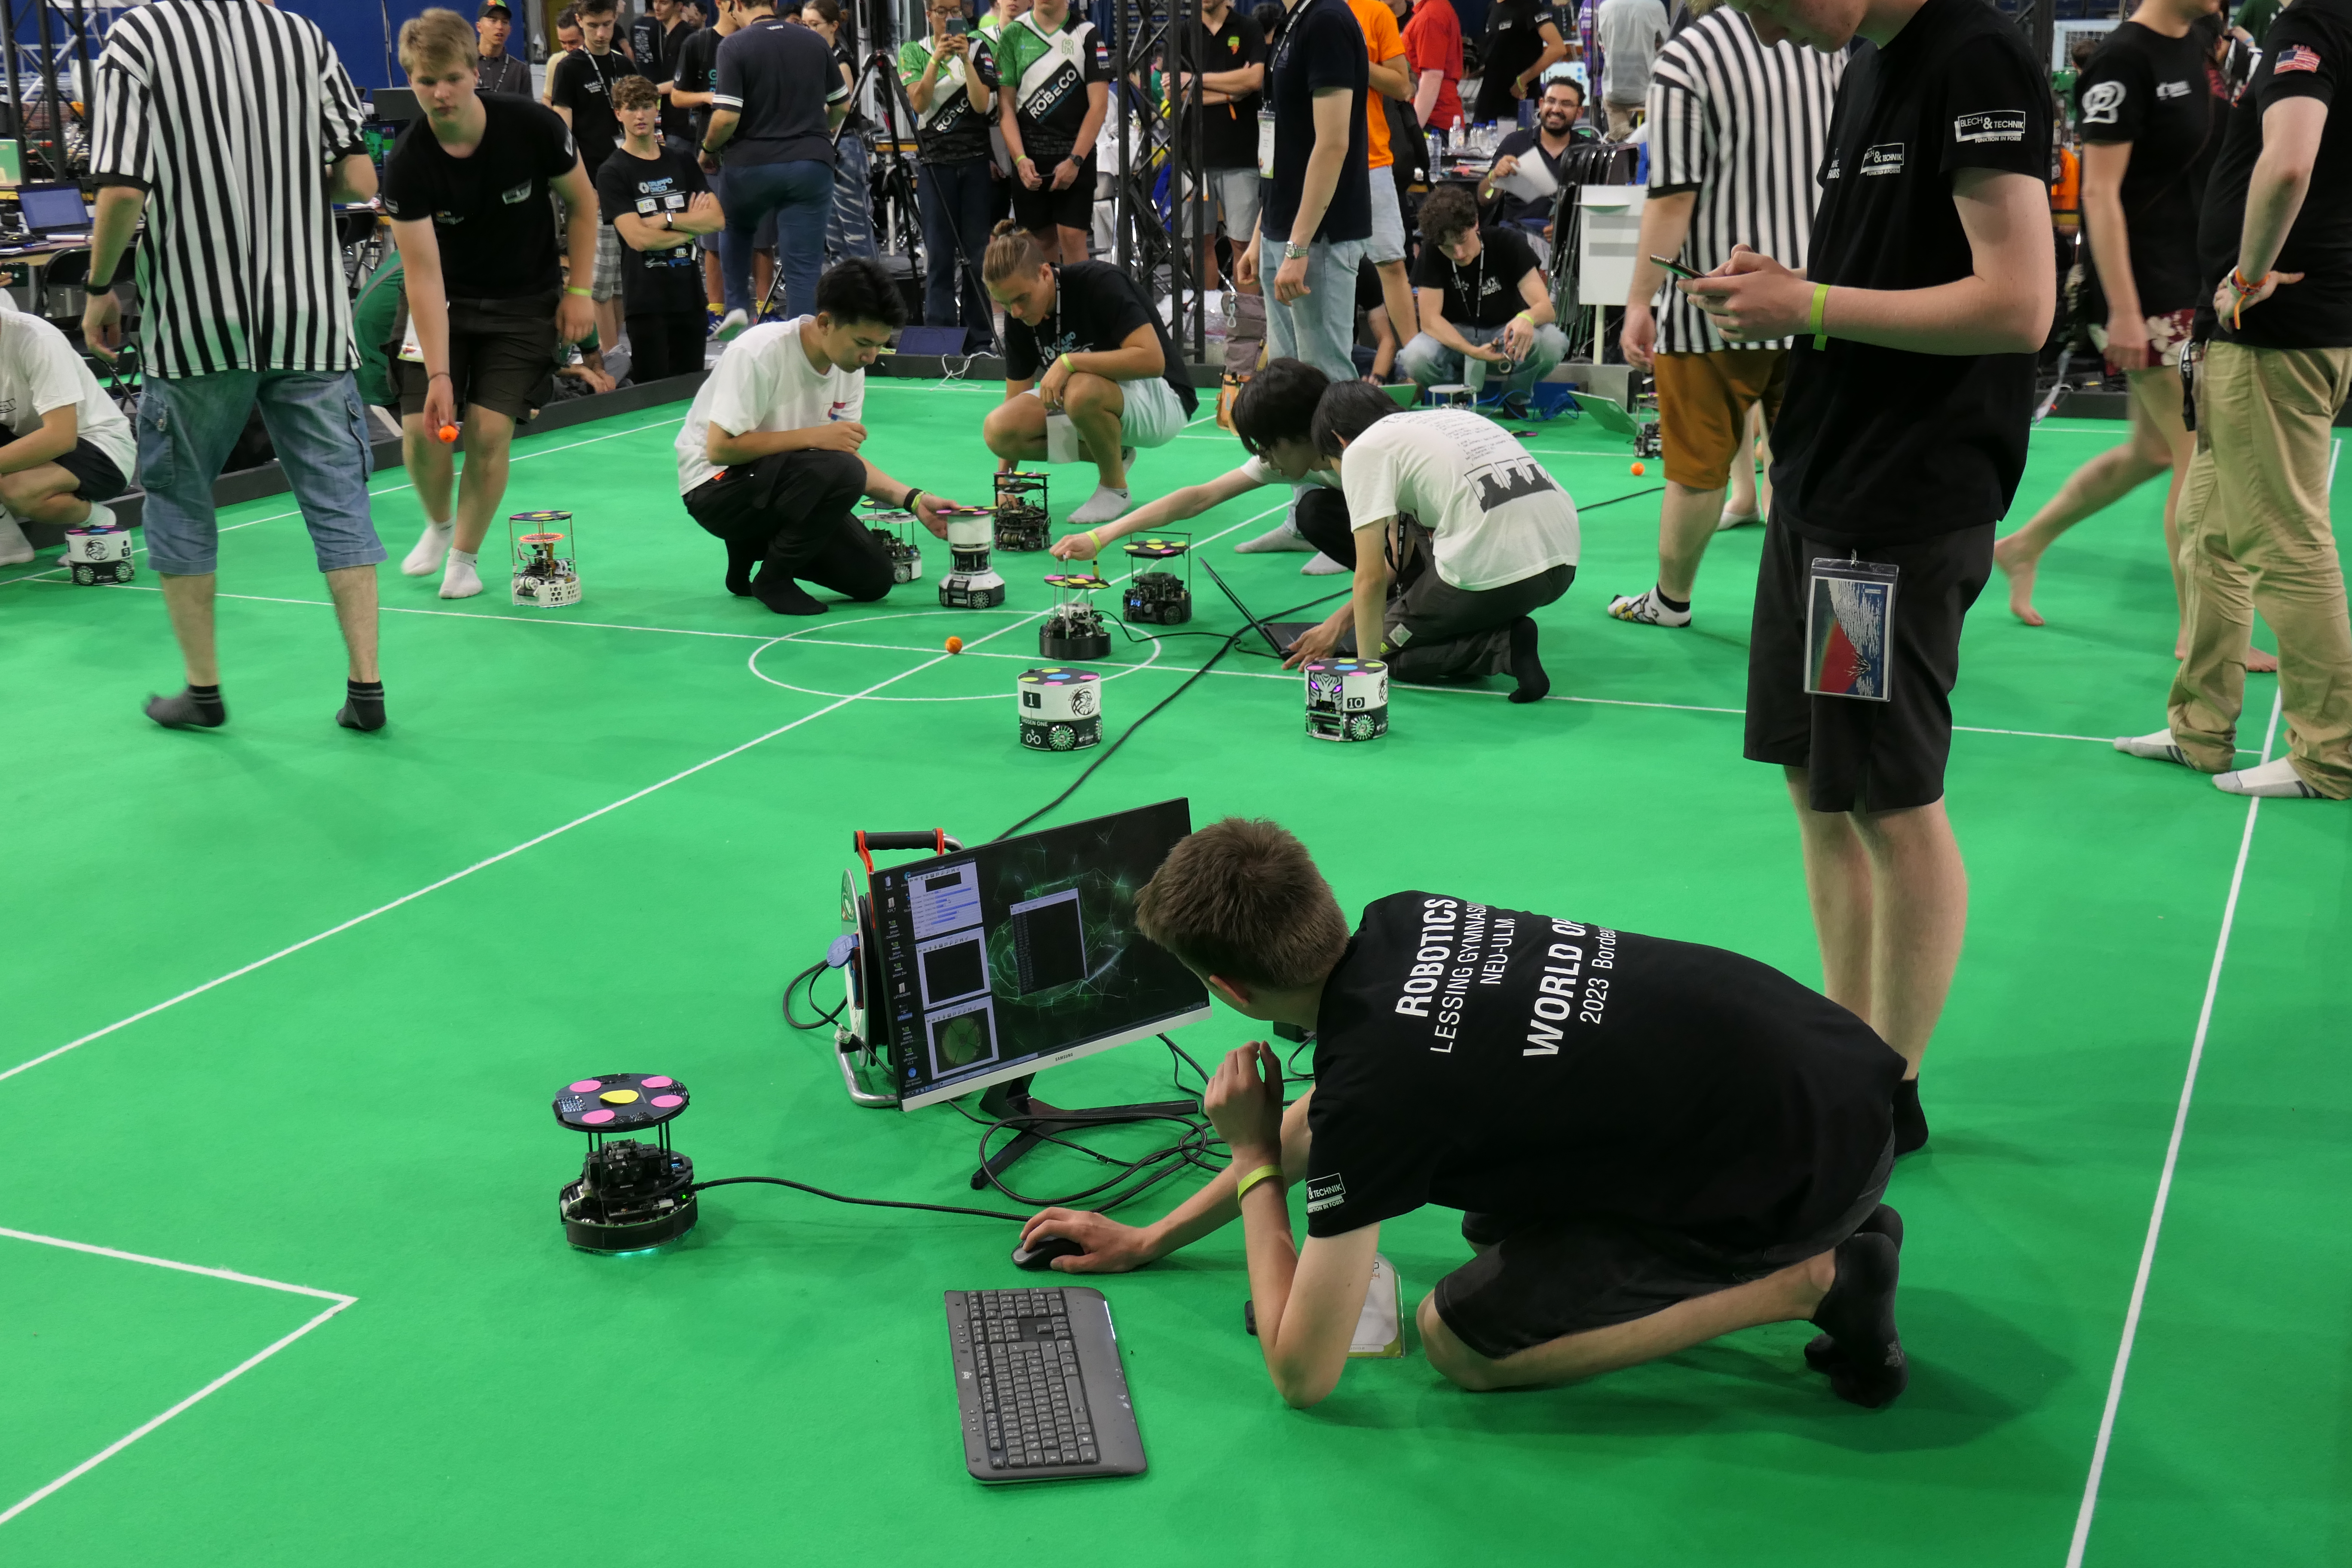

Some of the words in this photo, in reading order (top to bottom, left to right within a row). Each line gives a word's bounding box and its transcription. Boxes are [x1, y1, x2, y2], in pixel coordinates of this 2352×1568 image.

[1029, 69, 1077, 119] ROBECO
[1960, 116, 1983, 127] BLECH
[1983, 117, 1993, 129] &
[1994, 120, 2024, 129] TECHNIK
[1874, 151, 1882, 163] &
[1882, 153, 1902, 162] TECHNIK
[1029, 694, 1034, 706] 1
[1348, 698, 1363, 708] 10
[1395, 899, 1458, 1017] ROBOTICS
[1480, 919, 1515, 984] NEU-ULM
[1523, 943, 1583, 1056] WORLD
[1580, 978, 1609, 1024] 2023
[1430, 968, 1473, 1053] LESSING
[1055, 1053, 1073, 1062] SAMSUNG
[1308, 1186, 1314, 1200] &
[1313, 1184, 1342, 1197] TECHNIK
[1329, 1198, 1344, 1207] FORM
